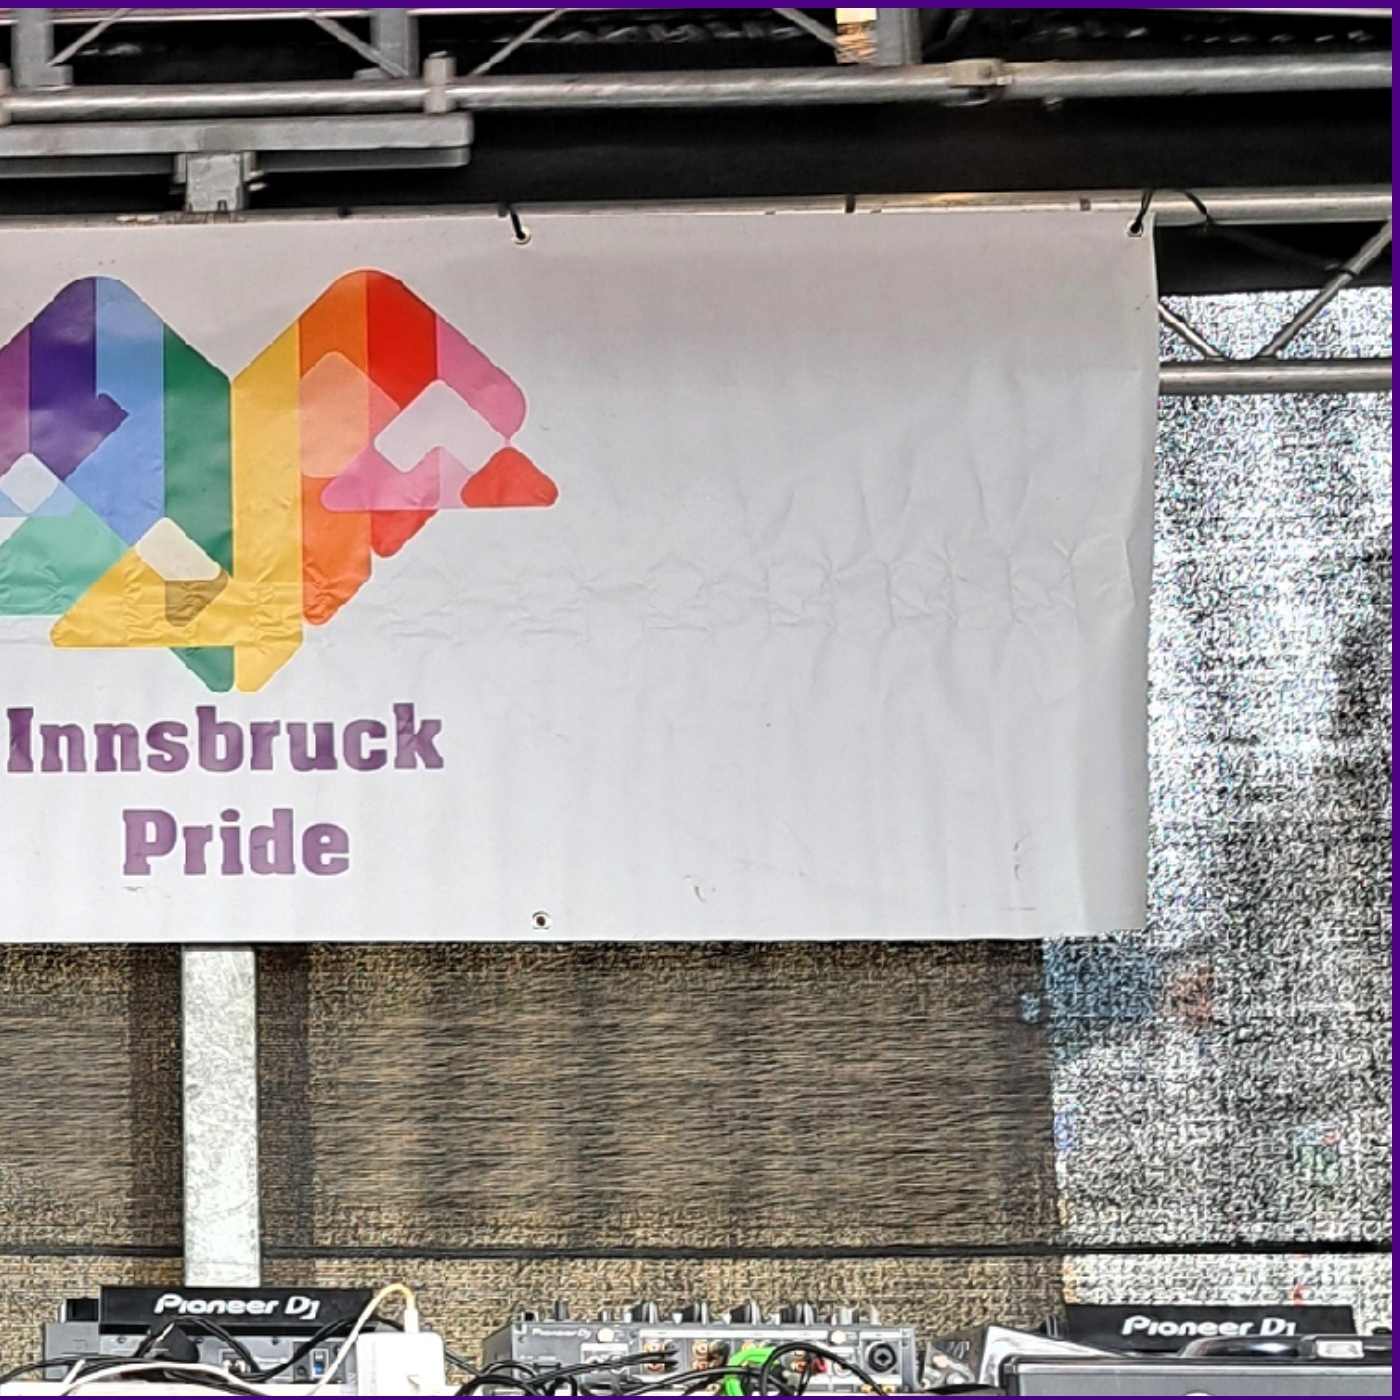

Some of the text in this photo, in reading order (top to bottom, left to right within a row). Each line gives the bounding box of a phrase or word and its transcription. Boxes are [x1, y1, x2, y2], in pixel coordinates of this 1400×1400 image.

[7, 703, 444, 773] Innsbruck
[122, 808, 350, 876] Pride
[154, 1293, 279, 1314] Pioneer
[1122, 1315, 1253, 1336] Pioneer
